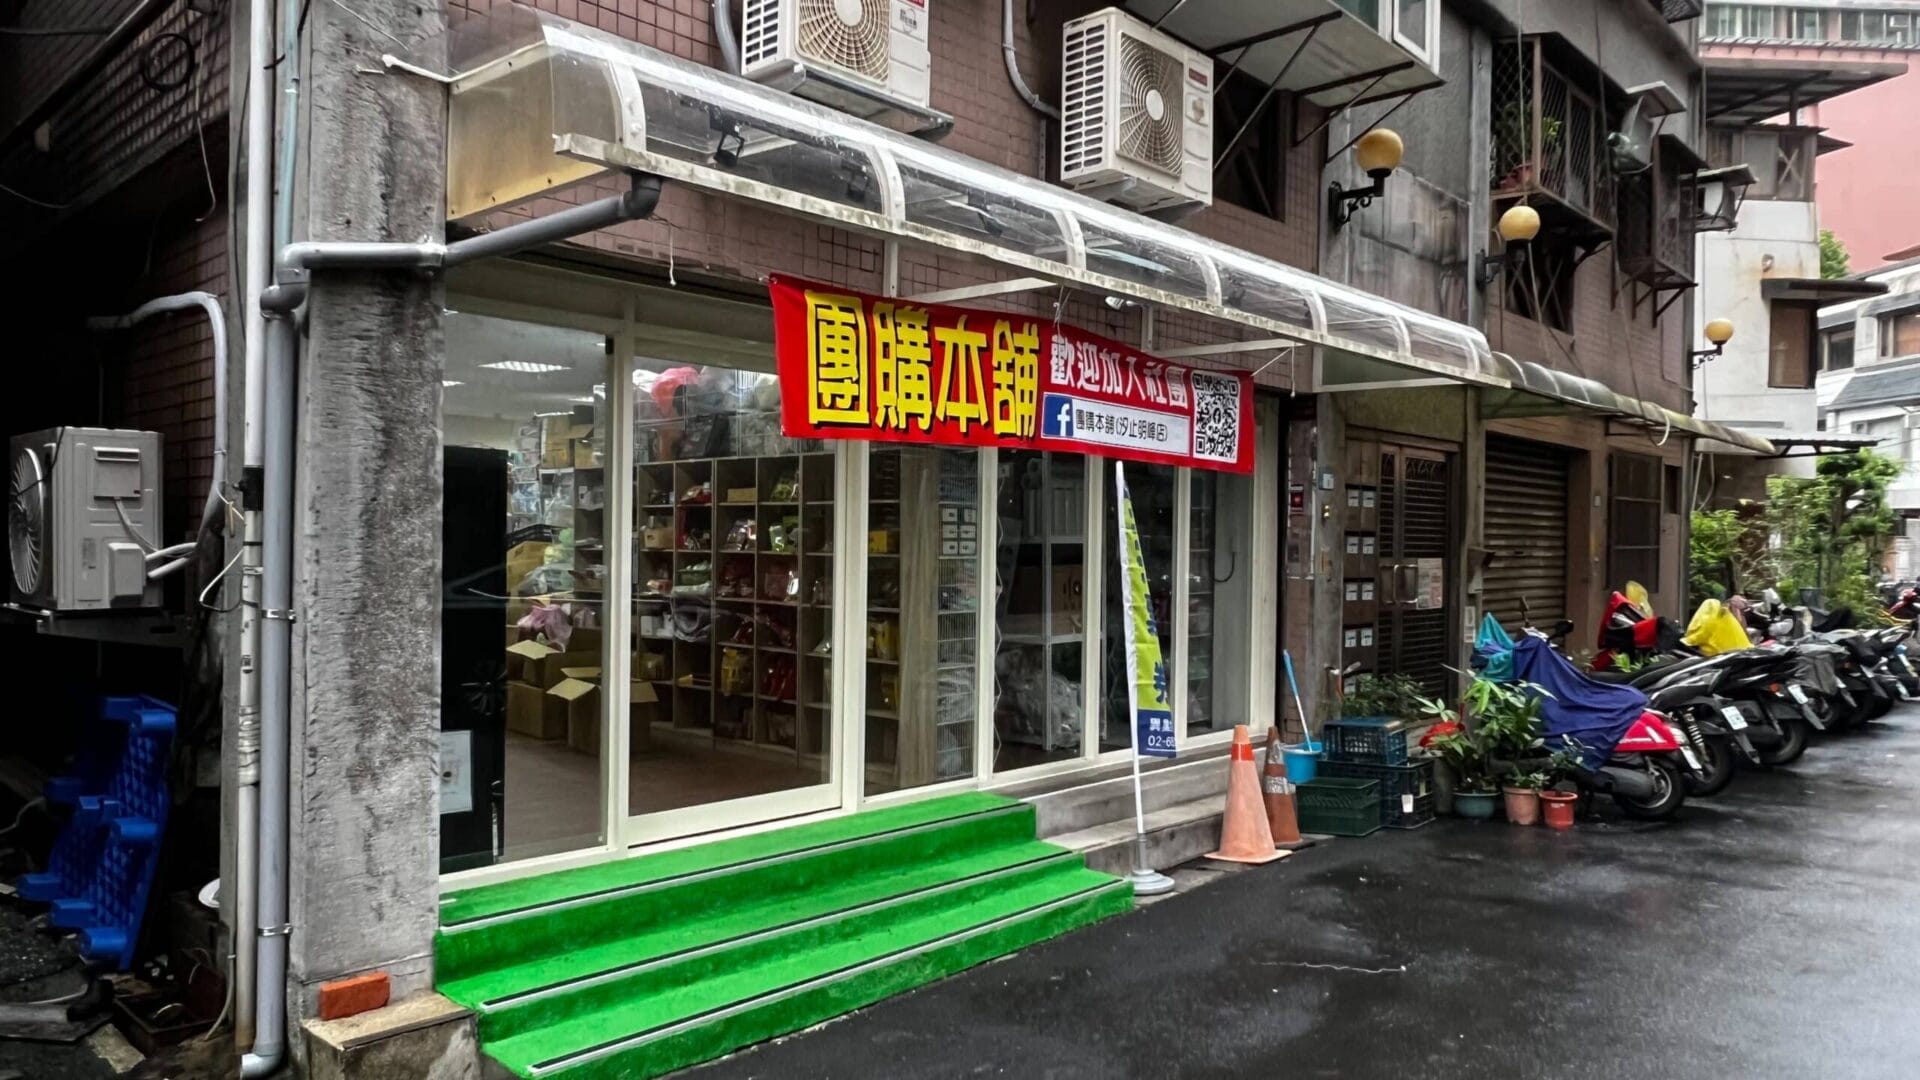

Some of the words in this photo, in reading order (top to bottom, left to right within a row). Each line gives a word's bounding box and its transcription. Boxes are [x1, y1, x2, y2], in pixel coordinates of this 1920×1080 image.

[804, 290, 1040, 438] 團購本舖
[1050, 334, 1189, 410] 歡迎加入社團
